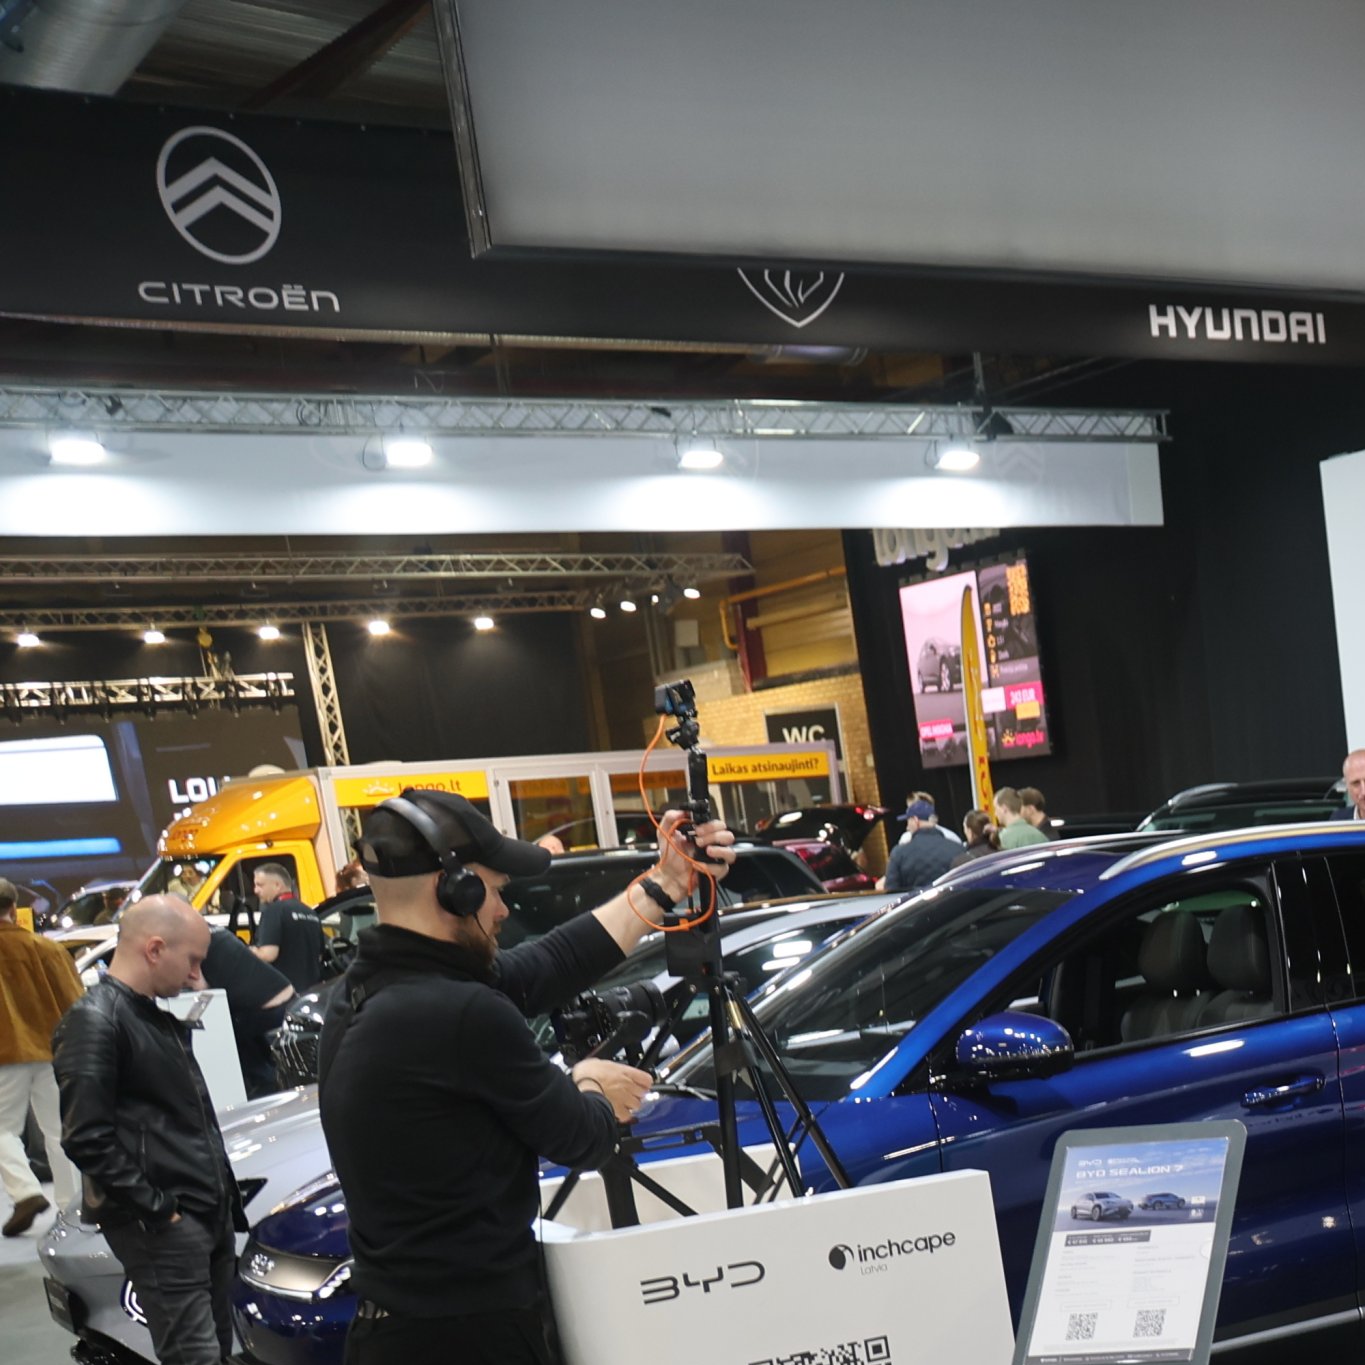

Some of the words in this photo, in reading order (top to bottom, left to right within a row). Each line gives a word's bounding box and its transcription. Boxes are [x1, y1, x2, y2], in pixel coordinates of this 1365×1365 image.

[138, 281, 340, 313] CITROËN
[1149, 305, 1326, 344] HYUNDAI
[782, 725, 825, 743] WC
[712, 763, 748, 776] Laikas
[751, 758, 819, 774] atsinaujinti?
[1076, 1169, 1106, 1179] BYD
[1109, 1165, 1171, 1177] SEALION
[857, 1231, 956, 1264] inchcape
[860, 1262, 889, 1276] Latvia
[640, 1259, 766, 1305] BYD
